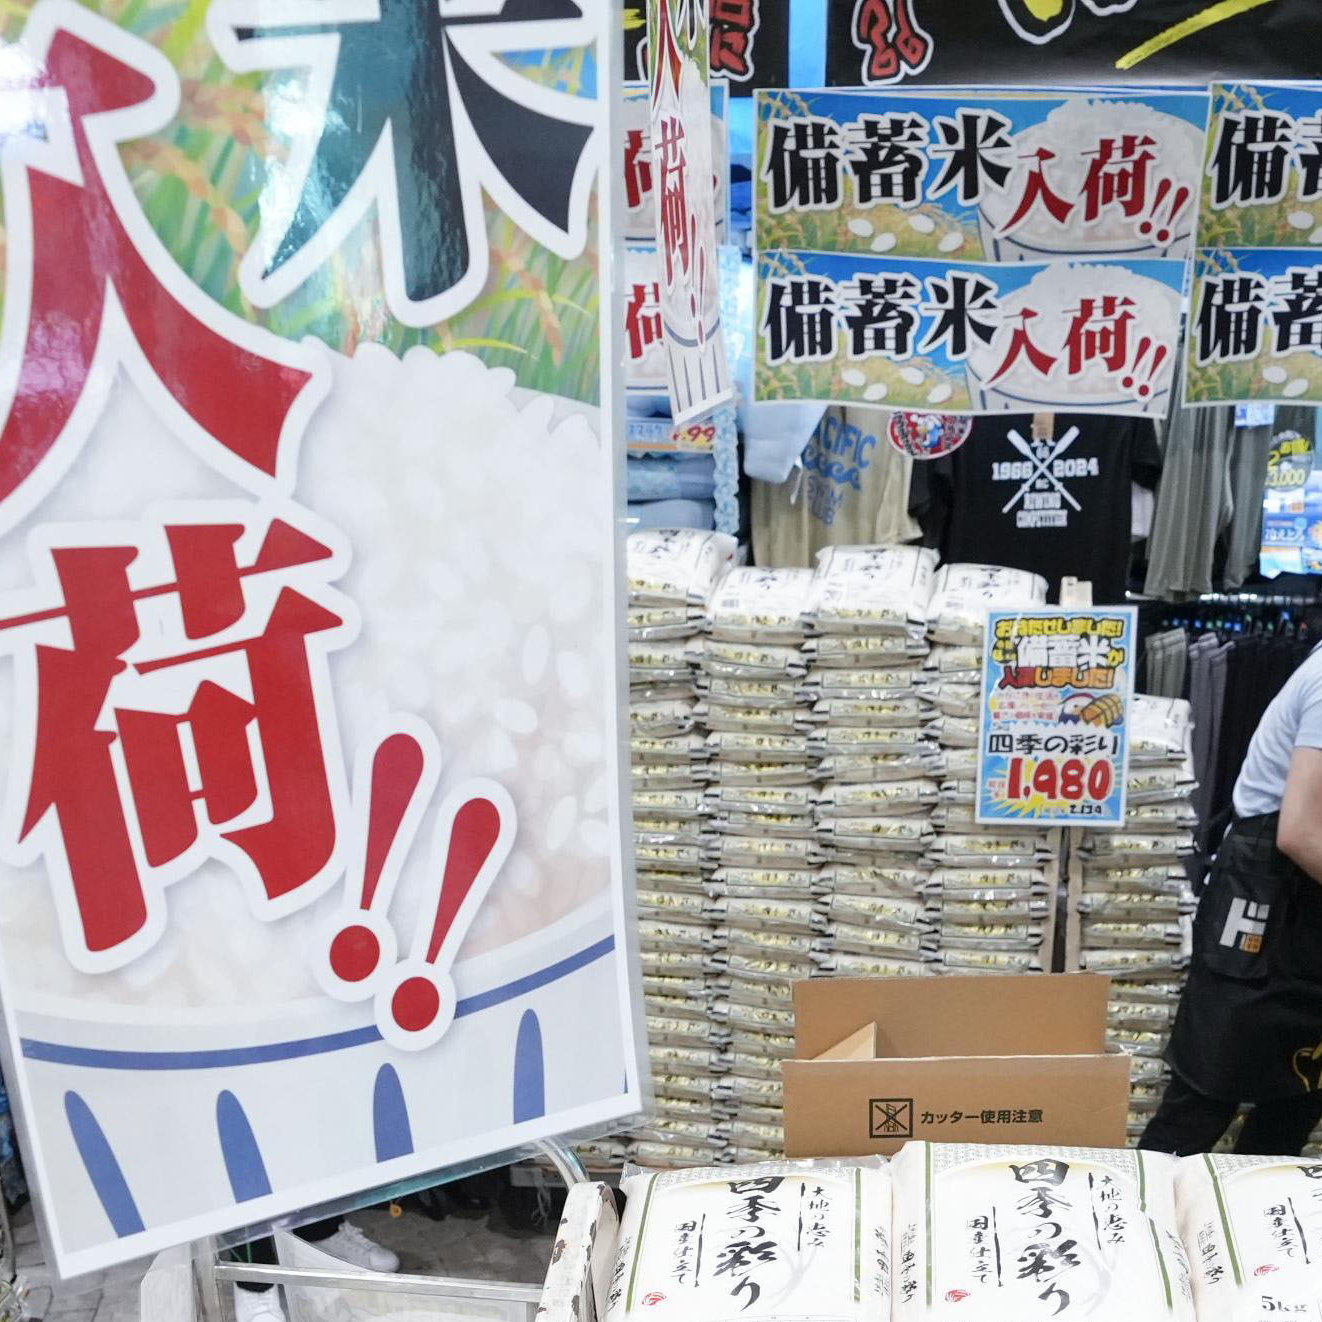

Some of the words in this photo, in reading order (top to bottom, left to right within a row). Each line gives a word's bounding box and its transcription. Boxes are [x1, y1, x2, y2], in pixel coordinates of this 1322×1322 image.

[989, 734, 1118, 754] 四季の彩り
[921, 1109, 1043, 1124] カッター使用注意
[1260, 1295, 1308, 1314] 5kg
